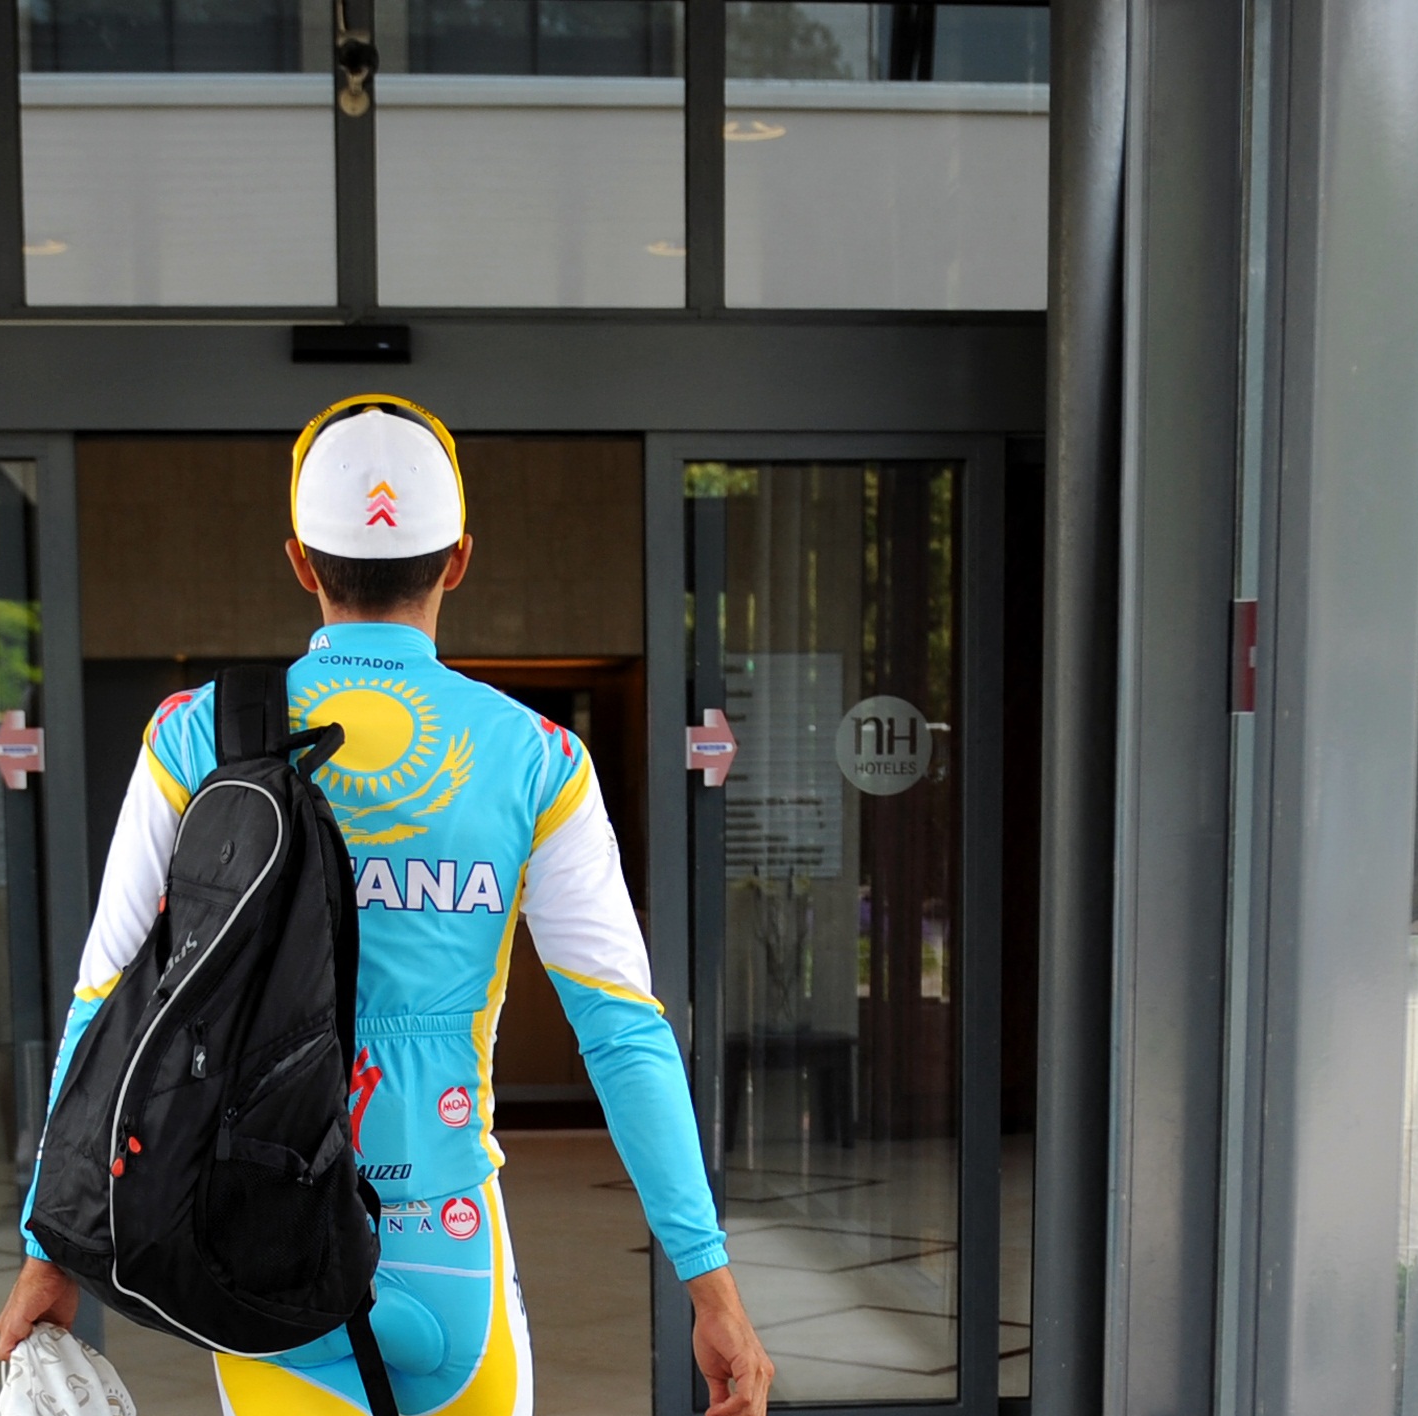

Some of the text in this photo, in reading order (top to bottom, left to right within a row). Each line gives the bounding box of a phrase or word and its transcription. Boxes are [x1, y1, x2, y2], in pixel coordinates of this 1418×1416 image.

[319, 655, 404, 670] CONTADOR
[854, 761, 917, 775] HOTELES
[350, 857, 504, 913] ANA
[443, 1098, 468, 1111] MOA
[355, 1164, 412, 1180] ALIZED
[449, 1212, 475, 1223] MOA
